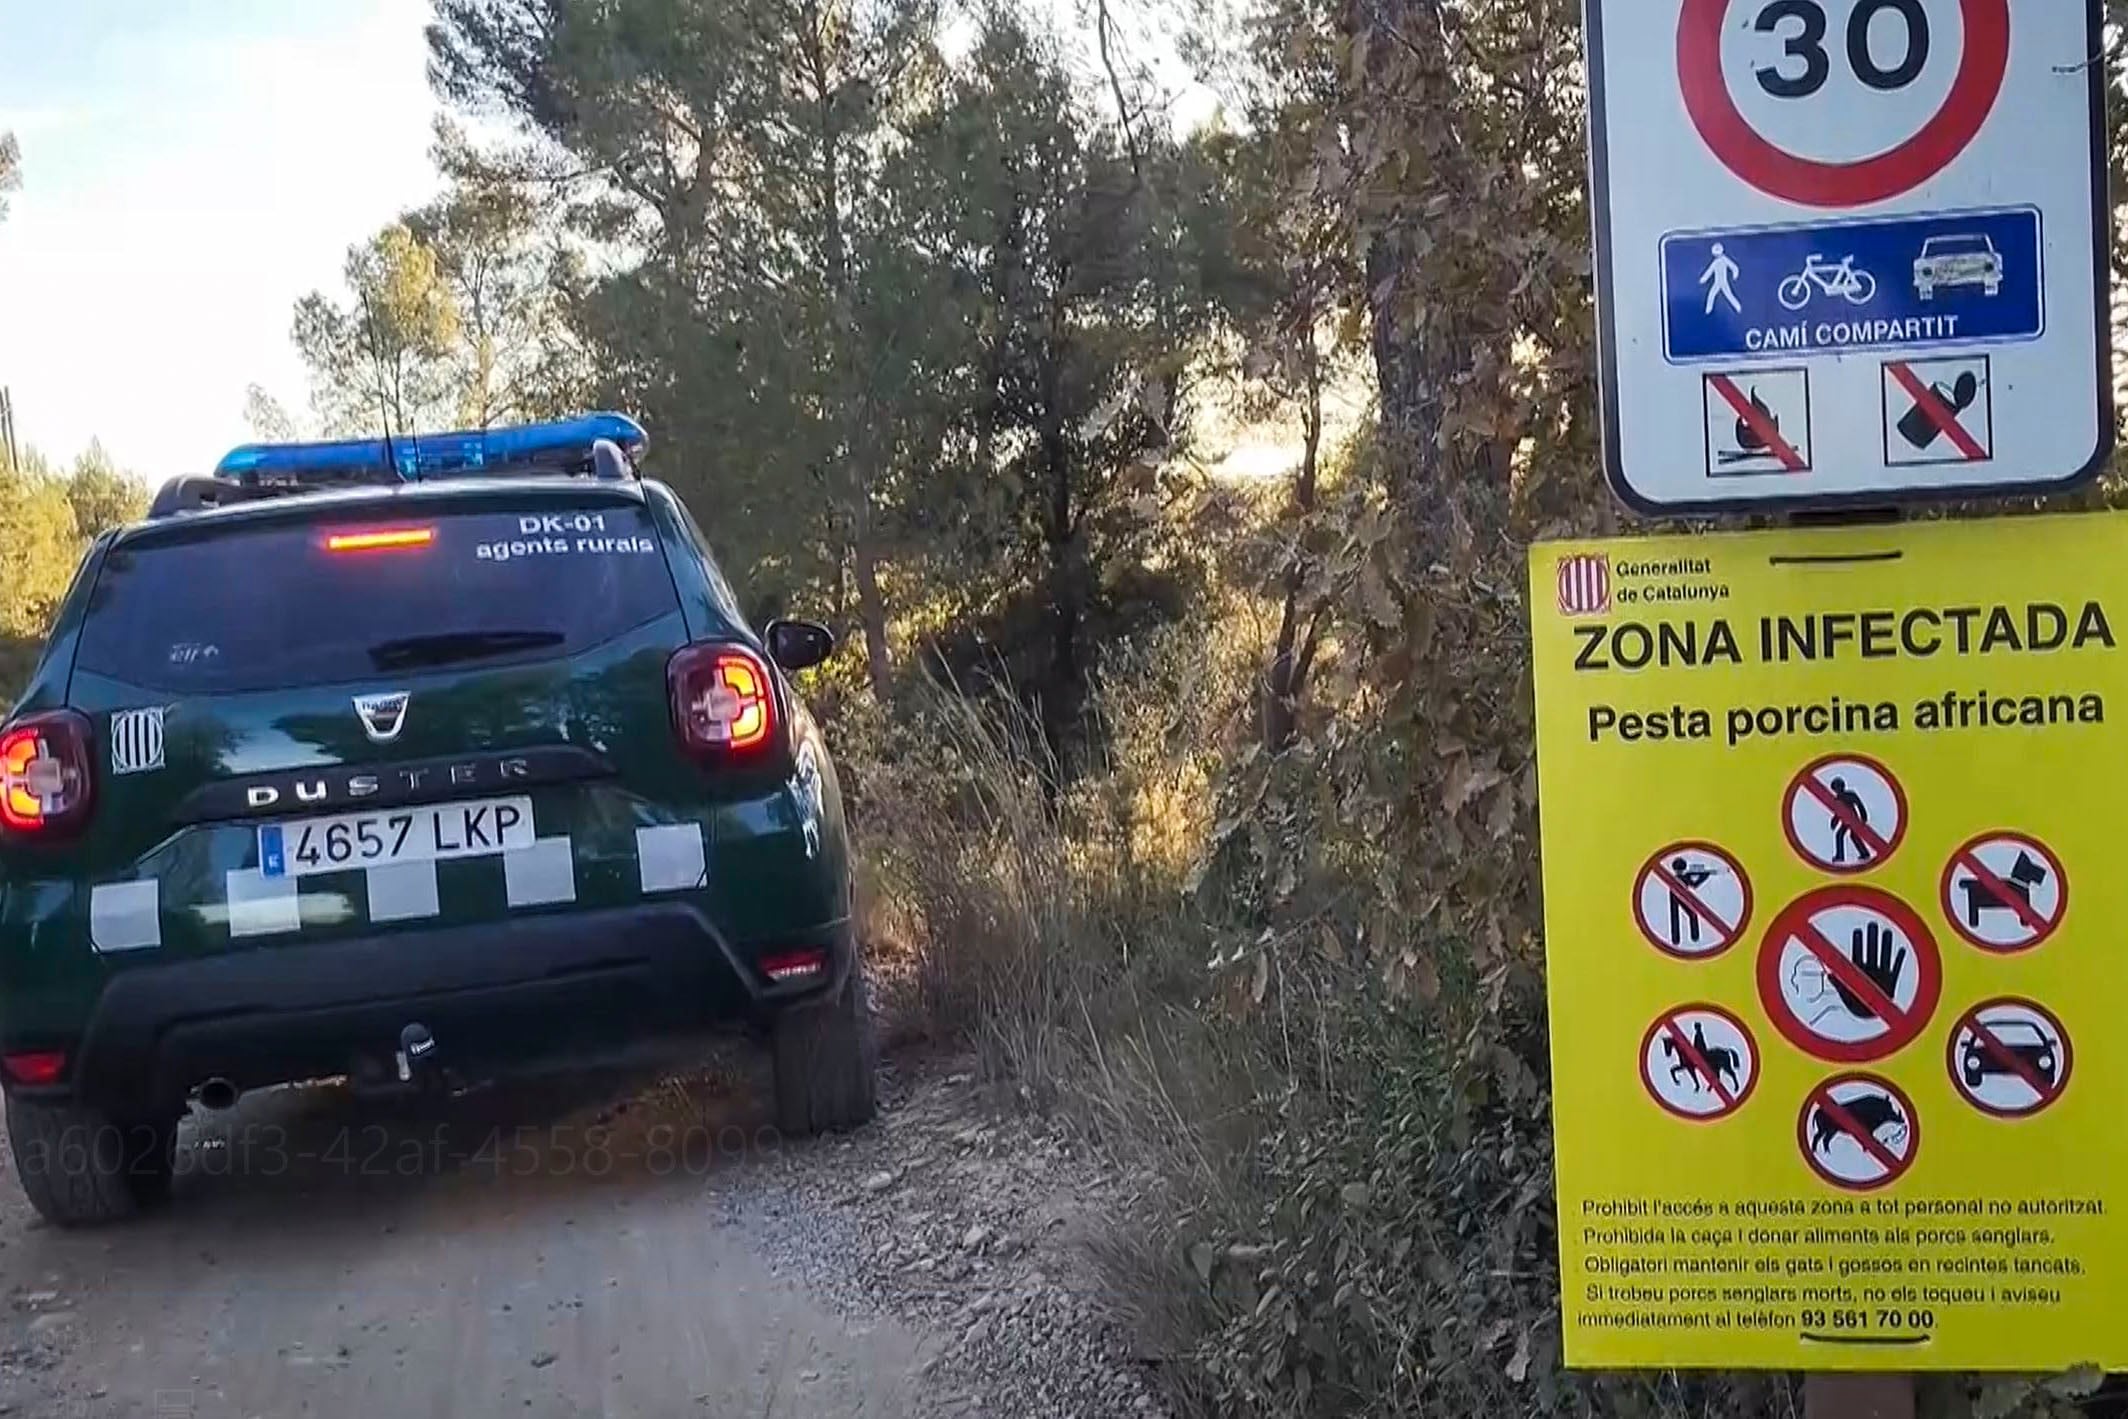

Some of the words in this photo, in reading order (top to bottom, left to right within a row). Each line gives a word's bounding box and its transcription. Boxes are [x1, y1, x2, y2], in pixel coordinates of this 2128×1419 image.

[1753, 0, 1930, 98] 30
[1745, 317, 1808, 350] CAMÍ
[1816, 314, 1959, 346] COMPARTIT
[518, 514, 605, 534] DK-01
[476, 537, 569, 561] agents
[577, 536, 655, 553] rurals
[1616, 559, 1711, 577] Generalitat
[1617, 587, 1638, 603] de
[1643, 584, 1729, 603] Catalunya
[1574, 620, 1743, 671] ZONA
[1761, 601, 2116, 663] INFECTADA
[1589, 704, 1711, 741] Pesta
[1728, 696, 1900, 745] porcina
[1914, 690, 2104, 728] africana
[247, 758, 528, 807] DUSTER
[295, 815, 413, 866] 4657
[432, 806, 521, 852] LKP
[1582, 1200, 1648, 1217] Prohibit
[1719, 1203, 1729, 1215] a
[1735, 1200, 1805, 1219] aquesta
[1811, 1202, 1854, 1215] zona
[1860, 1202, 1871, 1215] a
[1876, 1199, 1899, 1215] tot
[1905, 1199, 1983, 1218] personal
[1989, 1202, 2012, 1215] no
[1584, 1227, 1665, 1244] Prohibida
[1671, 1227, 1686, 1243] la
[1691, 1231, 1733, 1247] caça
[1748, 1227, 1799, 1243] donar
[1804, 1227, 1879, 1243] aliments
[1885, 1227, 1910, 1243] als
[1916, 1230, 1965, 1246] porcs
[1585, 1256, 1667, 1276] Obligatori
[1673, 1256, 1748, 1273] mantenir
[1755, 1256, 1780, 1272] els
[1786, 1257, 1823, 1277] gats
[1838, 1260, 1902, 1277] gossos
[1908, 1260, 1930, 1273] en
[1936, 1257, 2008, 1273] recintes
[1586, 1284, 1602, 1301] Si
[1608, 1285, 1663, 1301] trobeu
[1669, 1288, 1717, 1305] porcs
[1722, 1285, 1796, 1305] senglars
[1802, 1286, 1857, 1303] morts,
[1863, 1288, 1885, 1302] no
[1891, 1285, 1916, 1302] els
[1922, 1286, 1984, 1305] toqueu
[2001, 1286, 2060, 1302] aviseu
[1578, 1312, 1710, 1328] immediatament
[1716, 1312, 1731, 1328] al
[1801, 1310, 1826, 1328] 93
[1833, 1310, 1868, 1328] 561
[1876, 1310, 1902, 1328] 70
